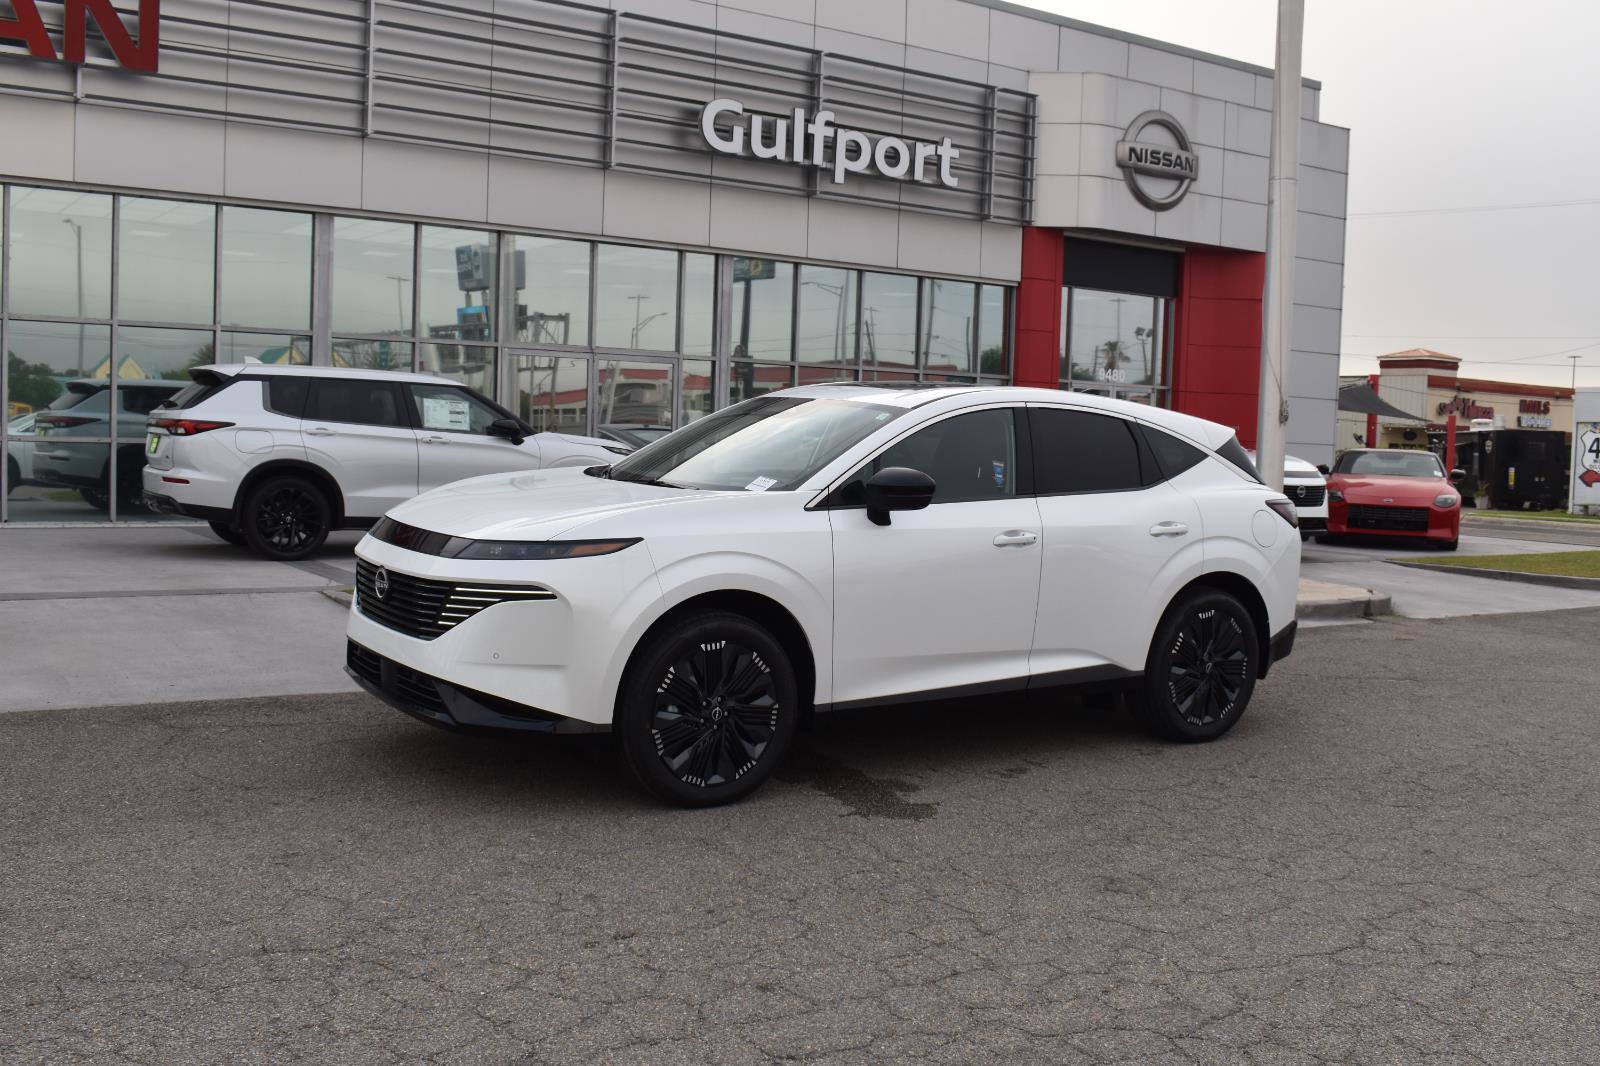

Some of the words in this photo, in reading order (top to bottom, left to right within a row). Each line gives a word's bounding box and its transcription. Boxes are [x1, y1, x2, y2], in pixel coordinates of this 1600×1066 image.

[700, 98, 960, 187] Gulfport
[1128, 146, 1194, 173] NISSAN
[1098, 368, 1126, 382] 9480
